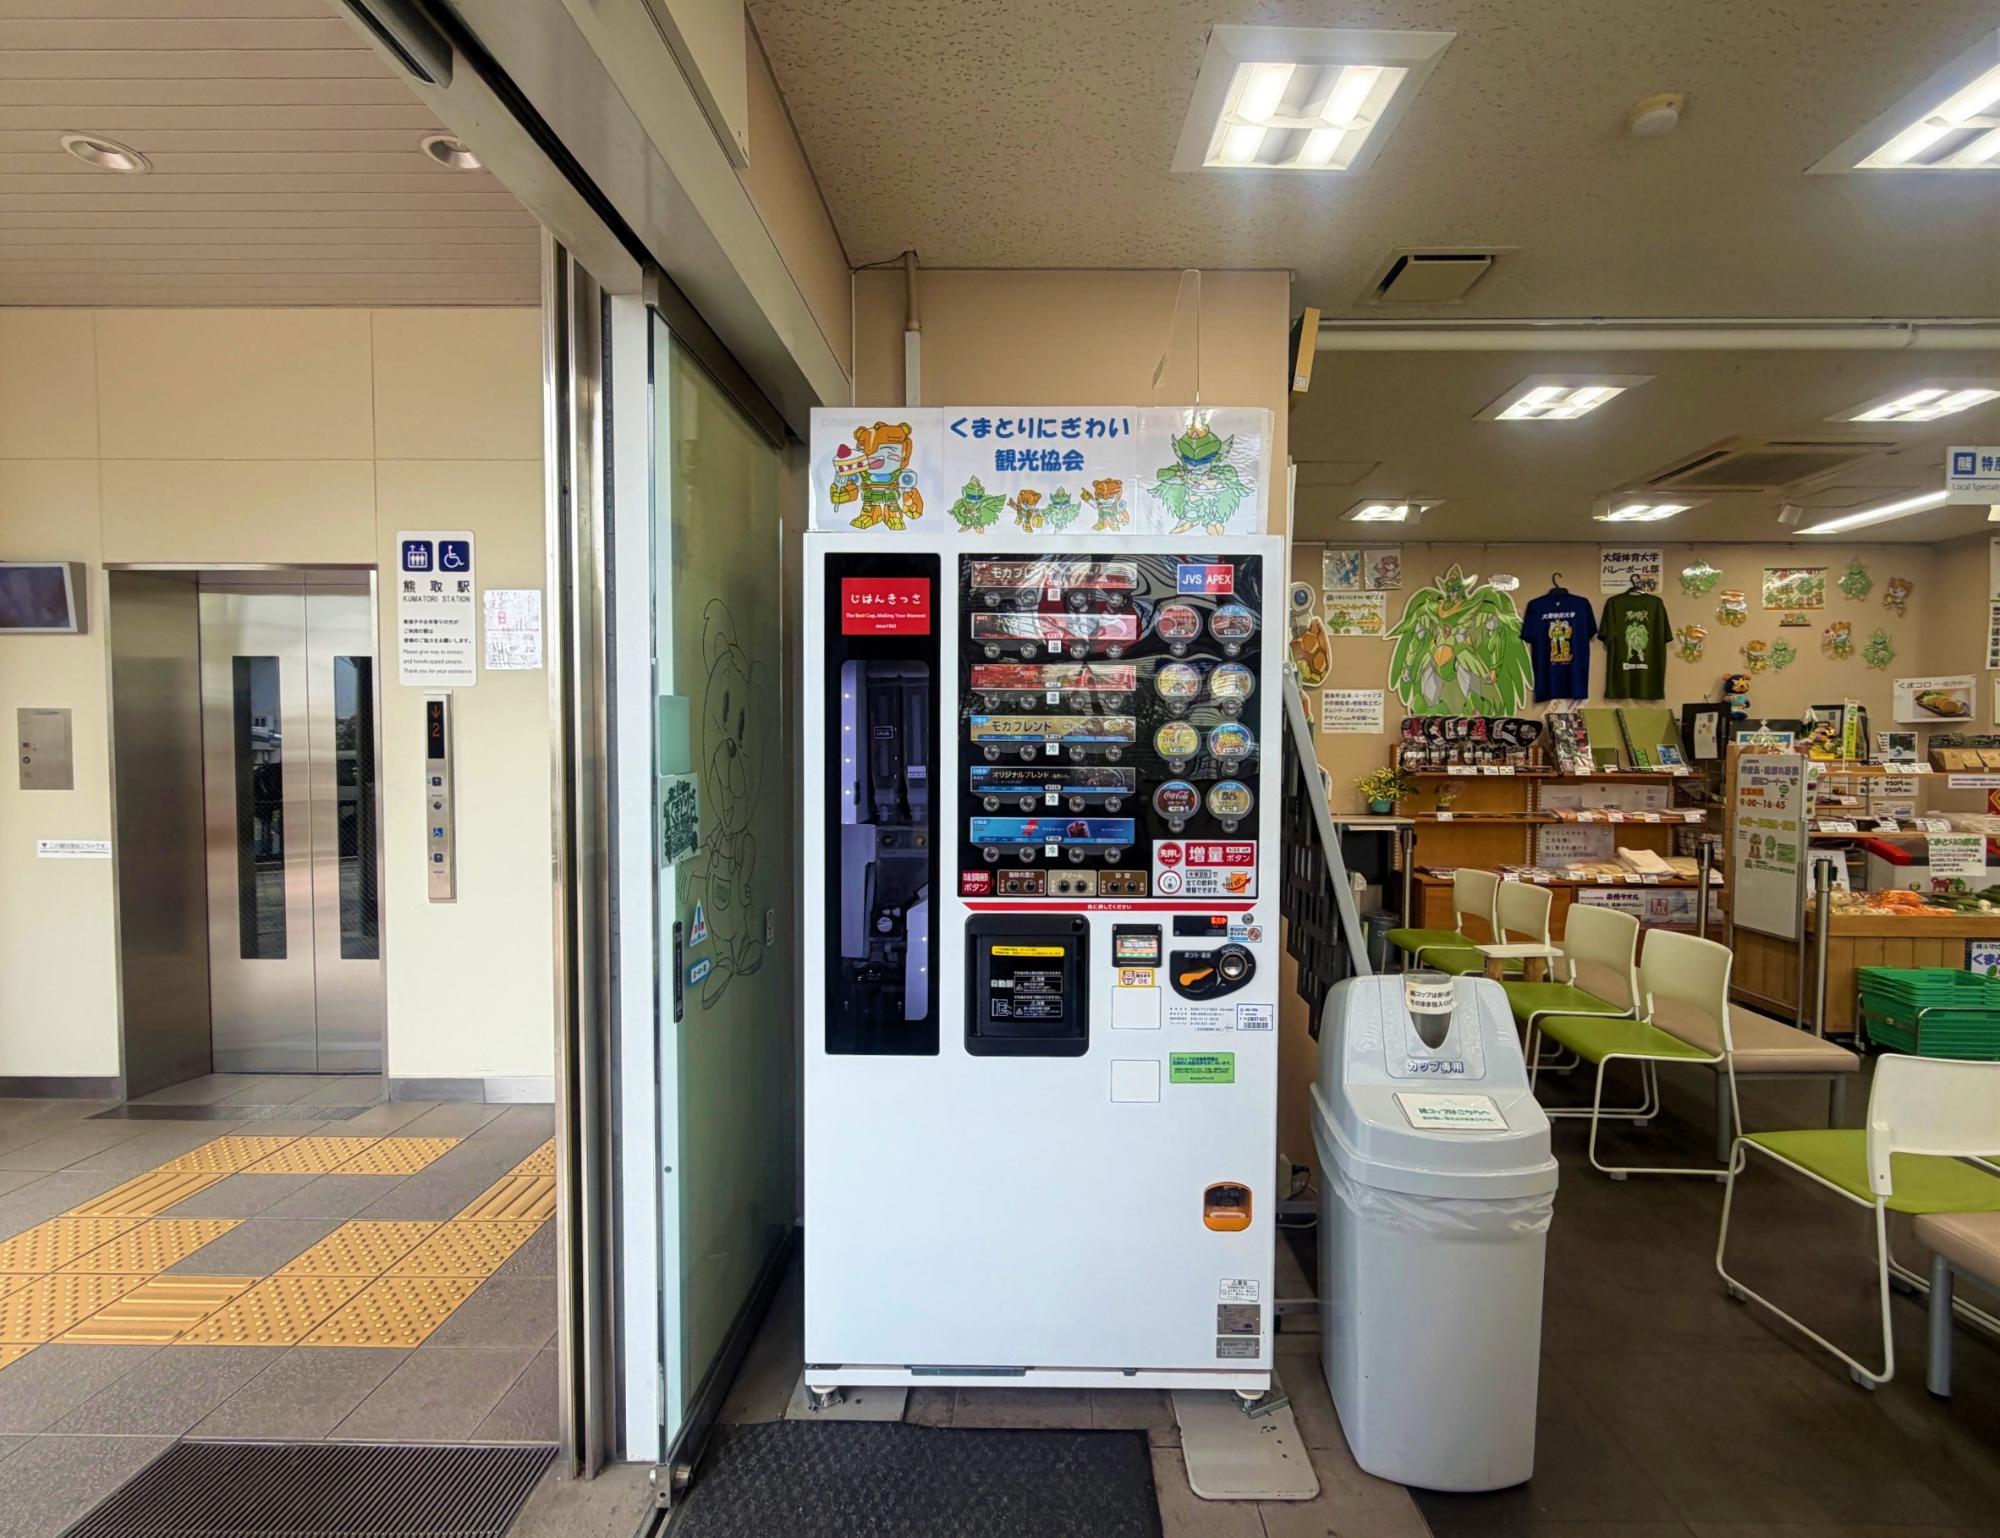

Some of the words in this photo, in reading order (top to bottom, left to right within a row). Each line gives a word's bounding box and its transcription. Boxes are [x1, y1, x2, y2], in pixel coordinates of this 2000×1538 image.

[949, 417, 1130, 440] くまとりにぎわい
[994, 449, 1085, 472] 観光協会
[1952, 482, 1971, 491] Local
[1603, 552, 1659, 562] 大阪体育大学
[1602, 565, 1660, 574] バレーボール部
[1182, 574, 1203, 585] JVS
[1206, 574, 1232, 585] APEX
[403, 580, 470, 593] 熊取駅
[403, 595, 438, 603] KUMATORI
[442, 595, 471, 603] STATION
[850, 593, 921, 605] じはんきっさ
[431, 723, 440, 738] 2
[991, 720, 1052, 733] モカブレンド
[991, 771, 1049, 779] オリジナルブレンド
[1160, 849, 1181, 858] 先押し
[1188, 846, 1224, 863] 増量
[1226, 854, 1251, 863] ボタン
[962, 872, 989, 882] 味調節
[963, 883, 988, 893] ボタン
[1407, 1060, 1465, 1074] カップ専用
